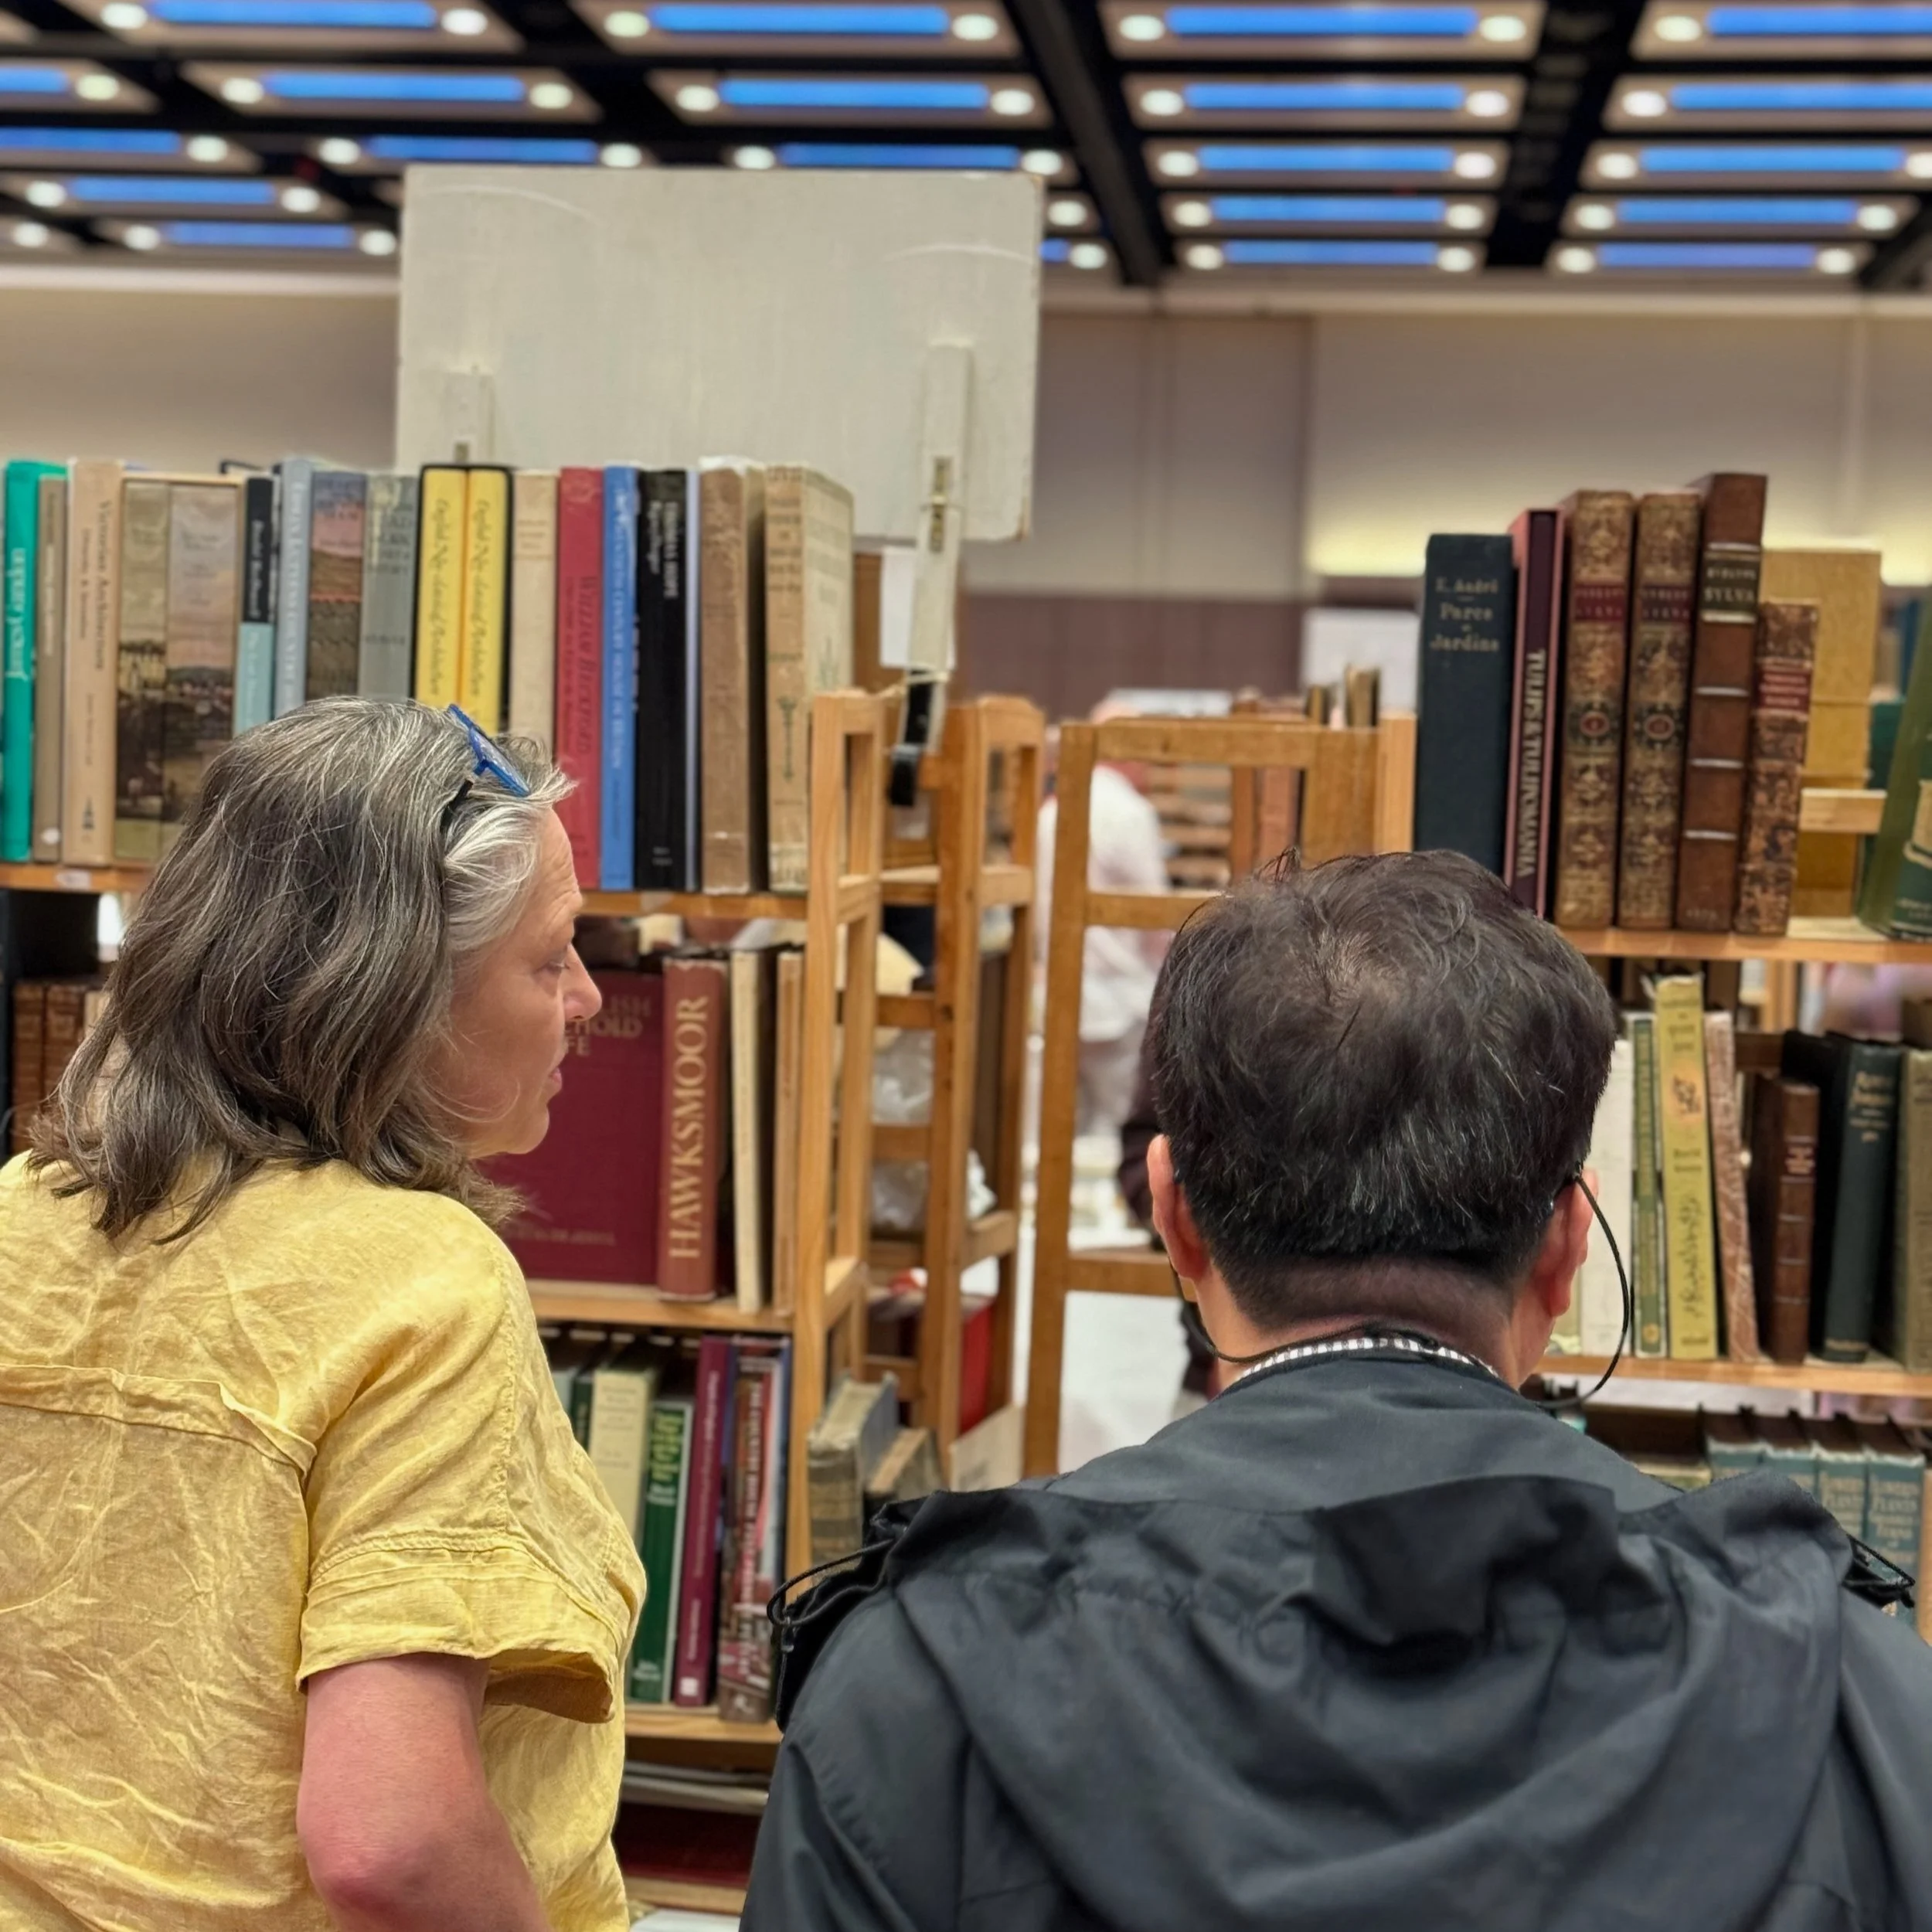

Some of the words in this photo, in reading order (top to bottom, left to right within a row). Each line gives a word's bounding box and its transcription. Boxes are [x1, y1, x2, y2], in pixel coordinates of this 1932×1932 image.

[98, 501, 111, 573] Victorian
[95, 577, 111, 672] Architecture
[1704, 587, 1755, 602] SYLVA
[1430, 634, 1500, 652] Jardins
[1524, 649, 1546, 719] TULIPS
[1523, 720, 1542, 736] &
[1516, 736, 1541, 878] TULIPOMANIA
[668, 996, 709, 1259] HAWKSMOOR
